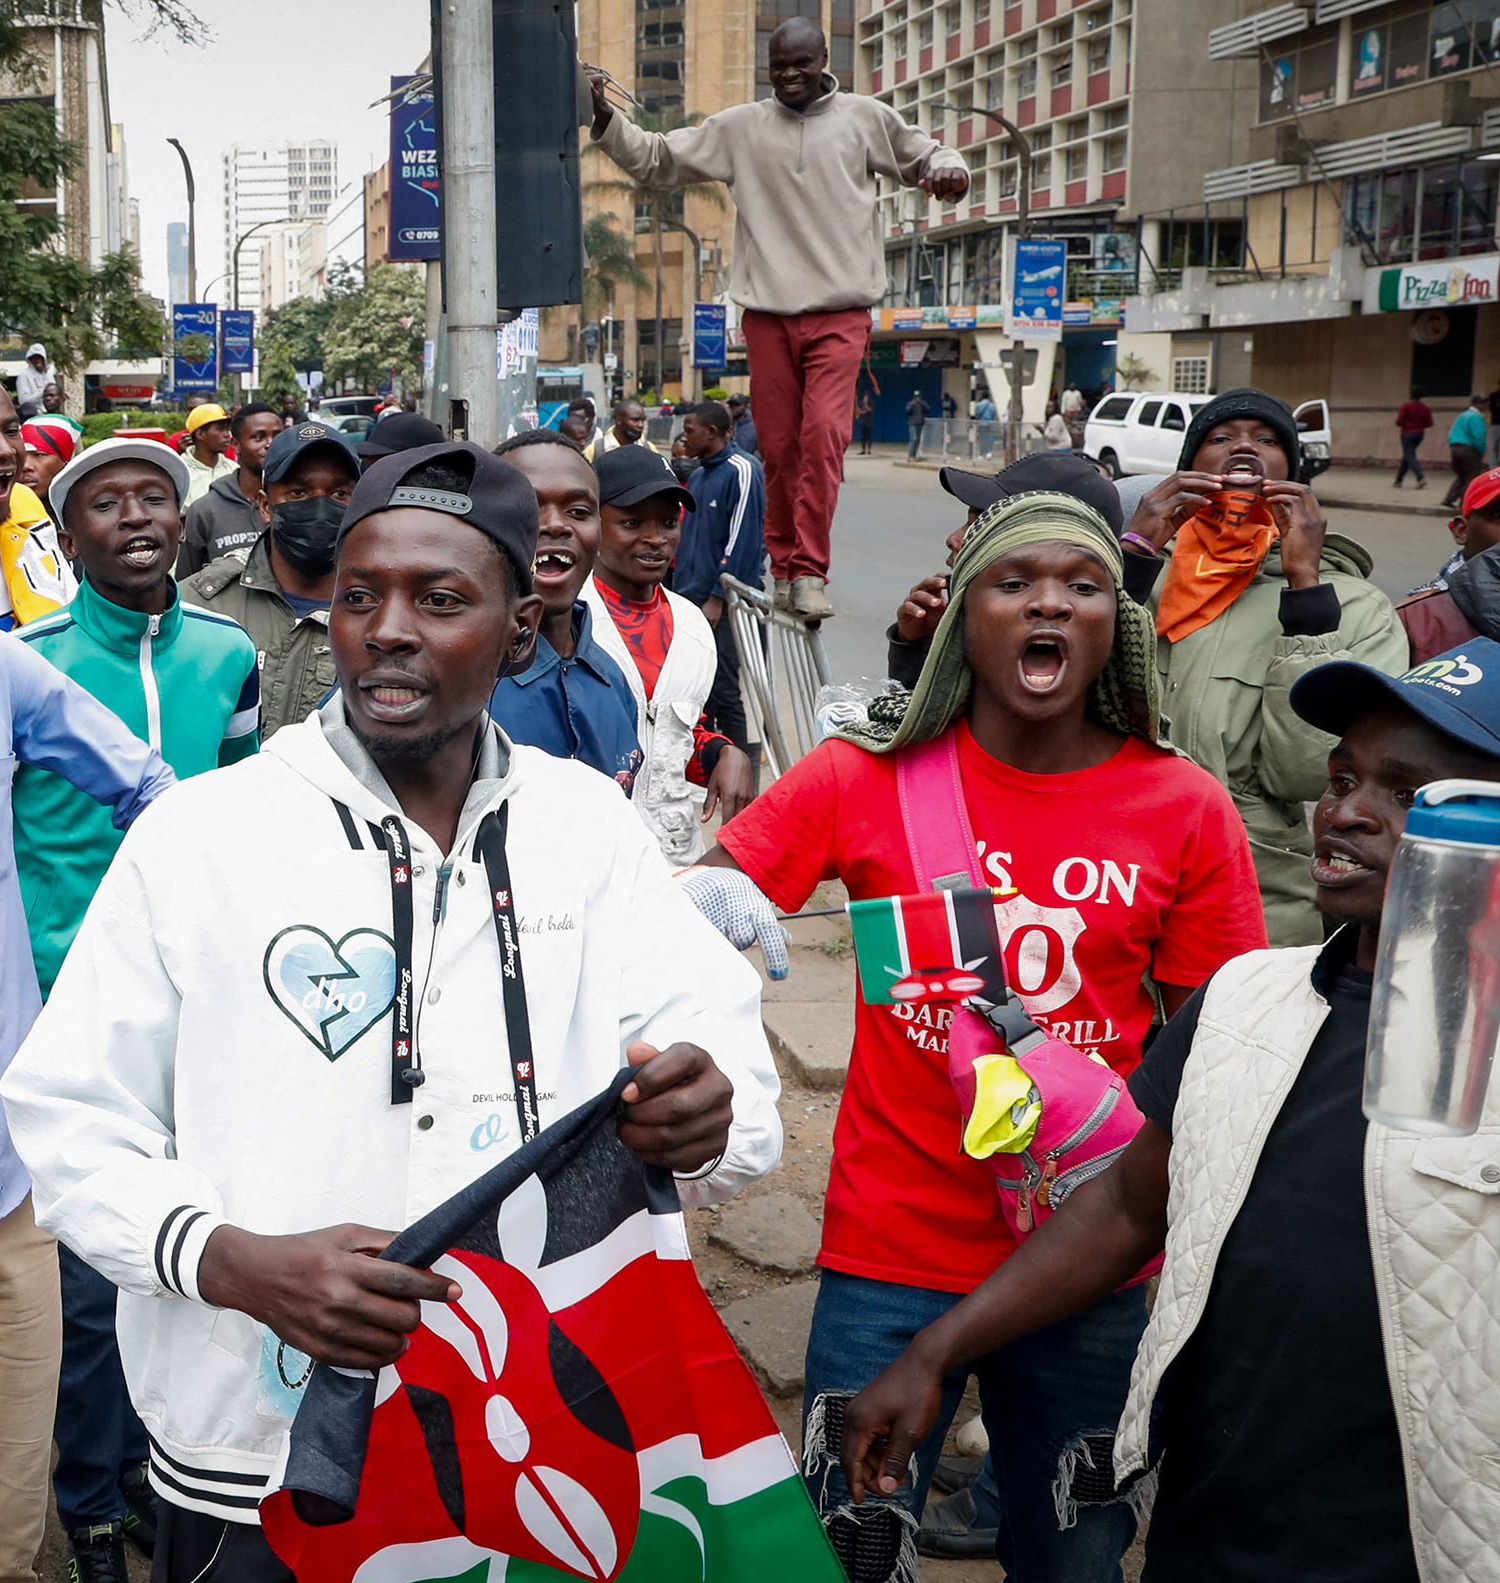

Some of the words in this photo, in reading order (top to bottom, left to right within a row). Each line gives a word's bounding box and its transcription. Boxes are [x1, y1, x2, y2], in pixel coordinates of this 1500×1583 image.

[1405, 275, 1448, 301] Pizza
[385, 819, 407, 860] ongmai
[1053, 857, 1141, 907] ON
[302, 976, 367, 1014] dho
[472, 1093, 494, 1103] DEVIL
